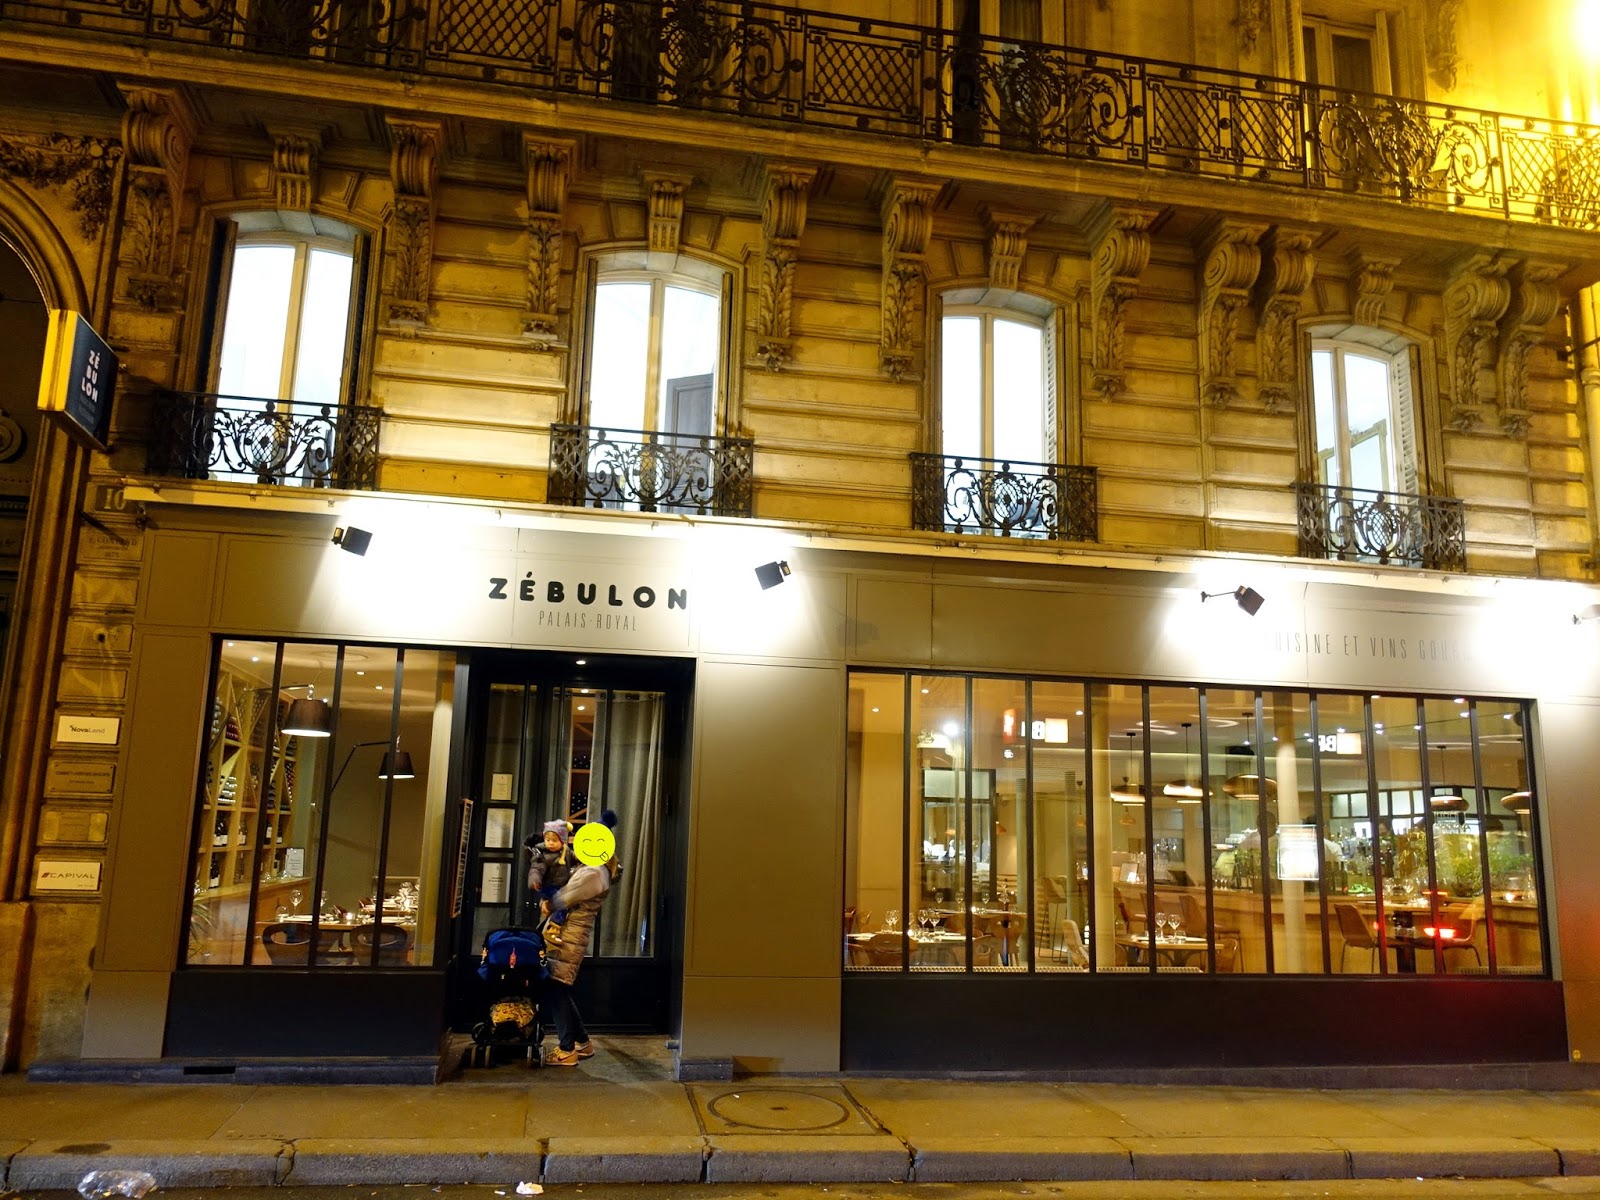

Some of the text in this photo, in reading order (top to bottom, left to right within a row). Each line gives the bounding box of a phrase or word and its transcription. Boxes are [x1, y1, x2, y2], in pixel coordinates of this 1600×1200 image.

[88, 350, 100, 370] ZÉ
[86, 365, 98, 385] BU
[81, 377, 98, 403] LON
[488, 571, 687, 610] ZÉBULON
[1274, 631, 1332, 655] UISINE
[1343, 635, 1359, 657] ET
[1370, 636, 1407, 660] VINS
